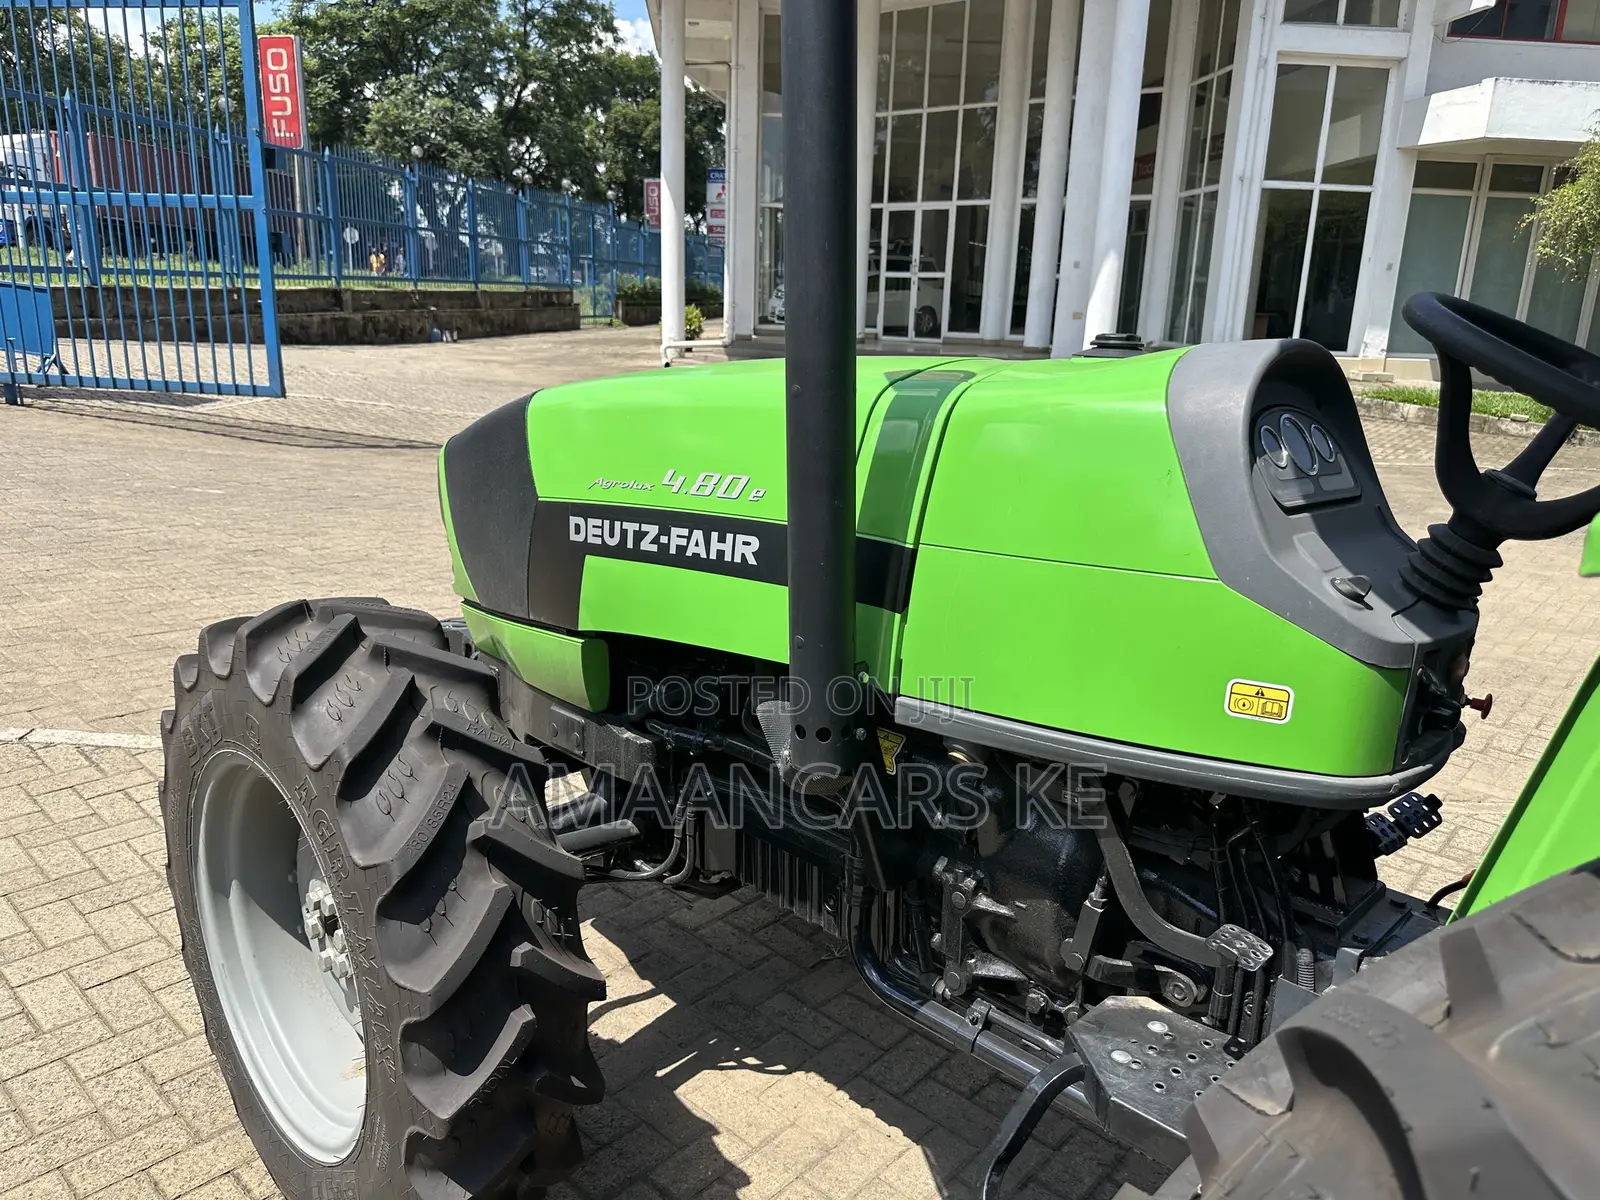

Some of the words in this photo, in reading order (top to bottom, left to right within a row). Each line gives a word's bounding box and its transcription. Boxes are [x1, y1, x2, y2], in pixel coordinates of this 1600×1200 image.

[266, 47, 294, 138] FUSO
[710, 172, 726, 180] CRA
[648, 186, 659, 225] FUSO
[587, 476, 656, 492] Agrolux
[661, 469, 751, 500] 4.80
[748, 486, 767, 502] e
[568, 514, 761, 566] DEUTZ-FAHR
